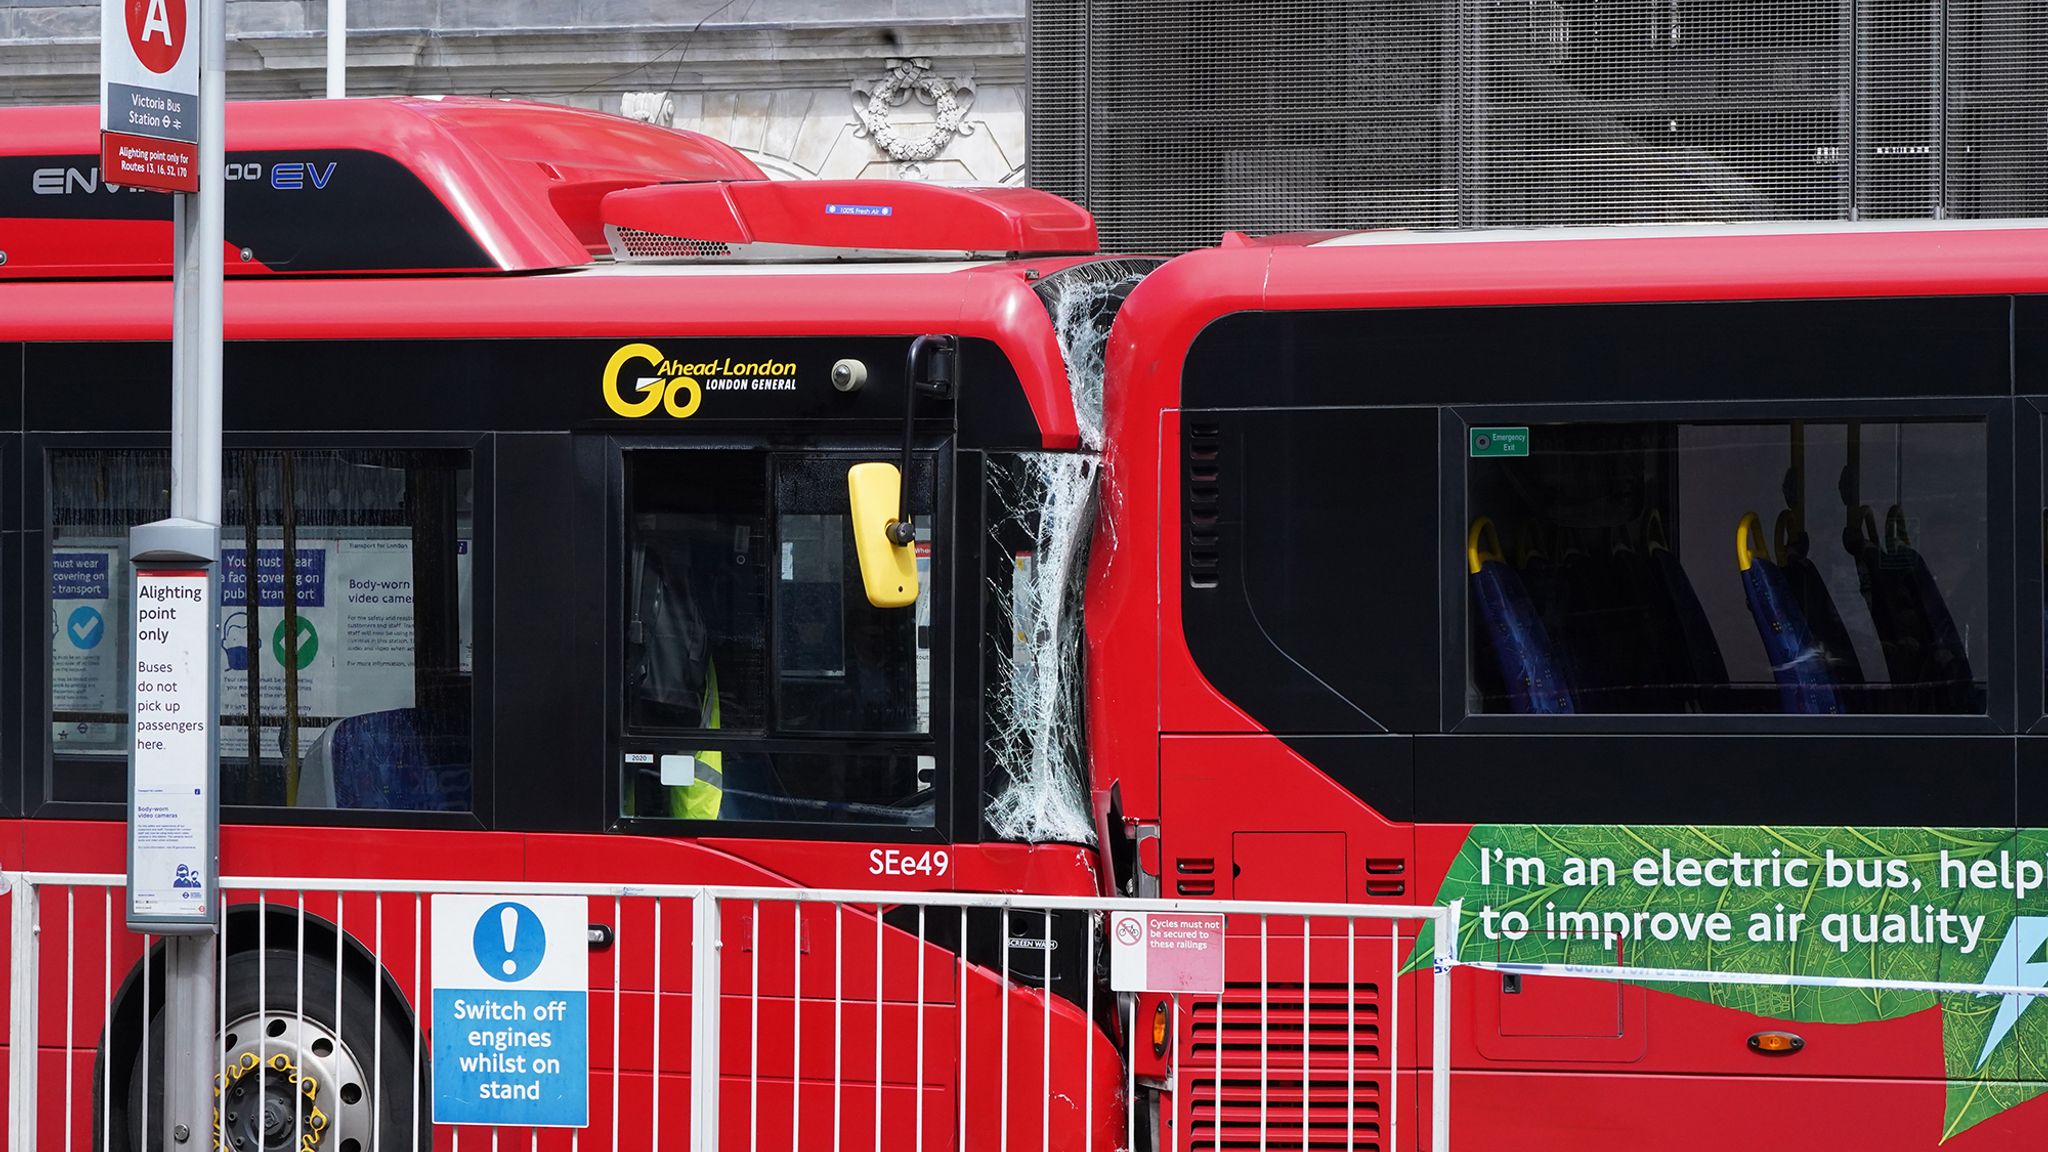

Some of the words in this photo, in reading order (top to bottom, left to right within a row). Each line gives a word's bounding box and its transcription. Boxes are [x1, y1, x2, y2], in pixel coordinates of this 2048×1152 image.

[141, 0, 173, 47] A
[130, 93, 165, 111] Victoria
[166, 98, 181, 113] Bus
[128, 110, 160, 127] Station
[119, 146, 148, 161] Alighting
[149, 150, 166, 161] point
[166, 153, 179, 164] only
[180, 153, 189, 164] for
[121, 160, 145, 172] Routes
[177, 167, 187, 177] 170
[224, 163, 262, 181] 00
[271, 162, 337, 190] EV
[602, 342, 702, 419] Go
[657, 358, 797, 376] Ahead-London
[705, 379, 748, 391] LONDON
[751, 378, 797, 391] GENERAL
[1492, 433, 1526, 443] Emergency
[1503, 443, 1516, 451] Exit
[76, 560, 99, 568] wear
[294, 558, 312, 567] ear
[53, 571, 91, 583] covering
[228, 571, 247, 583] fac
[305, 574, 320, 583] on
[58, 585, 101, 595] transport
[349, 579, 411, 591] Body-worn
[139, 585, 202, 602] Alighting
[261, 590, 315, 600] tranort
[348, 593, 379, 603] video
[382, 595, 413, 603] came
[139, 607, 176, 622] point
[138, 628, 169, 644] only
[138, 661, 173, 673] Buses
[138, 681, 154, 692] do
[156, 682, 178, 692] not
[138, 700, 161, 713] pick
[165, 703, 181, 714] up
[137, 721, 204, 733] passengers
[137, 739, 167, 750] here.
[868, 848, 949, 877] SEe49
[1480, 847, 1545, 886] I’m
[1562, 856, 1616, 887] an
[1632, 848, 1809, 887] electric
[1825, 849, 1922, 893] bus,
[1939, 850, 2048, 899] help
[1150, 919, 1178, 930] Cycles
[1180, 920, 1203, 928] must
[1204, 921, 1220, 929] not
[1479, 905, 1530, 940] to
[1545, 901, 1732, 950] improve
[1747, 903, 1806, 942] air
[1820, 904, 1986, 954] quality
[1150, 930, 1161, 938] be
[1163, 930, 1197, 939] secured
[1150, 940, 1174, 949] these
[1176, 940, 1208, 951] railings
[454, 999, 526, 1021] Switch
[533, 1001, 567, 1021] off
[468, 1027, 552, 1051] engines
[459, 1053, 526, 1073] whilst
[532, 1058, 560, 1074] on
[479, 1080, 540, 1100] stand
